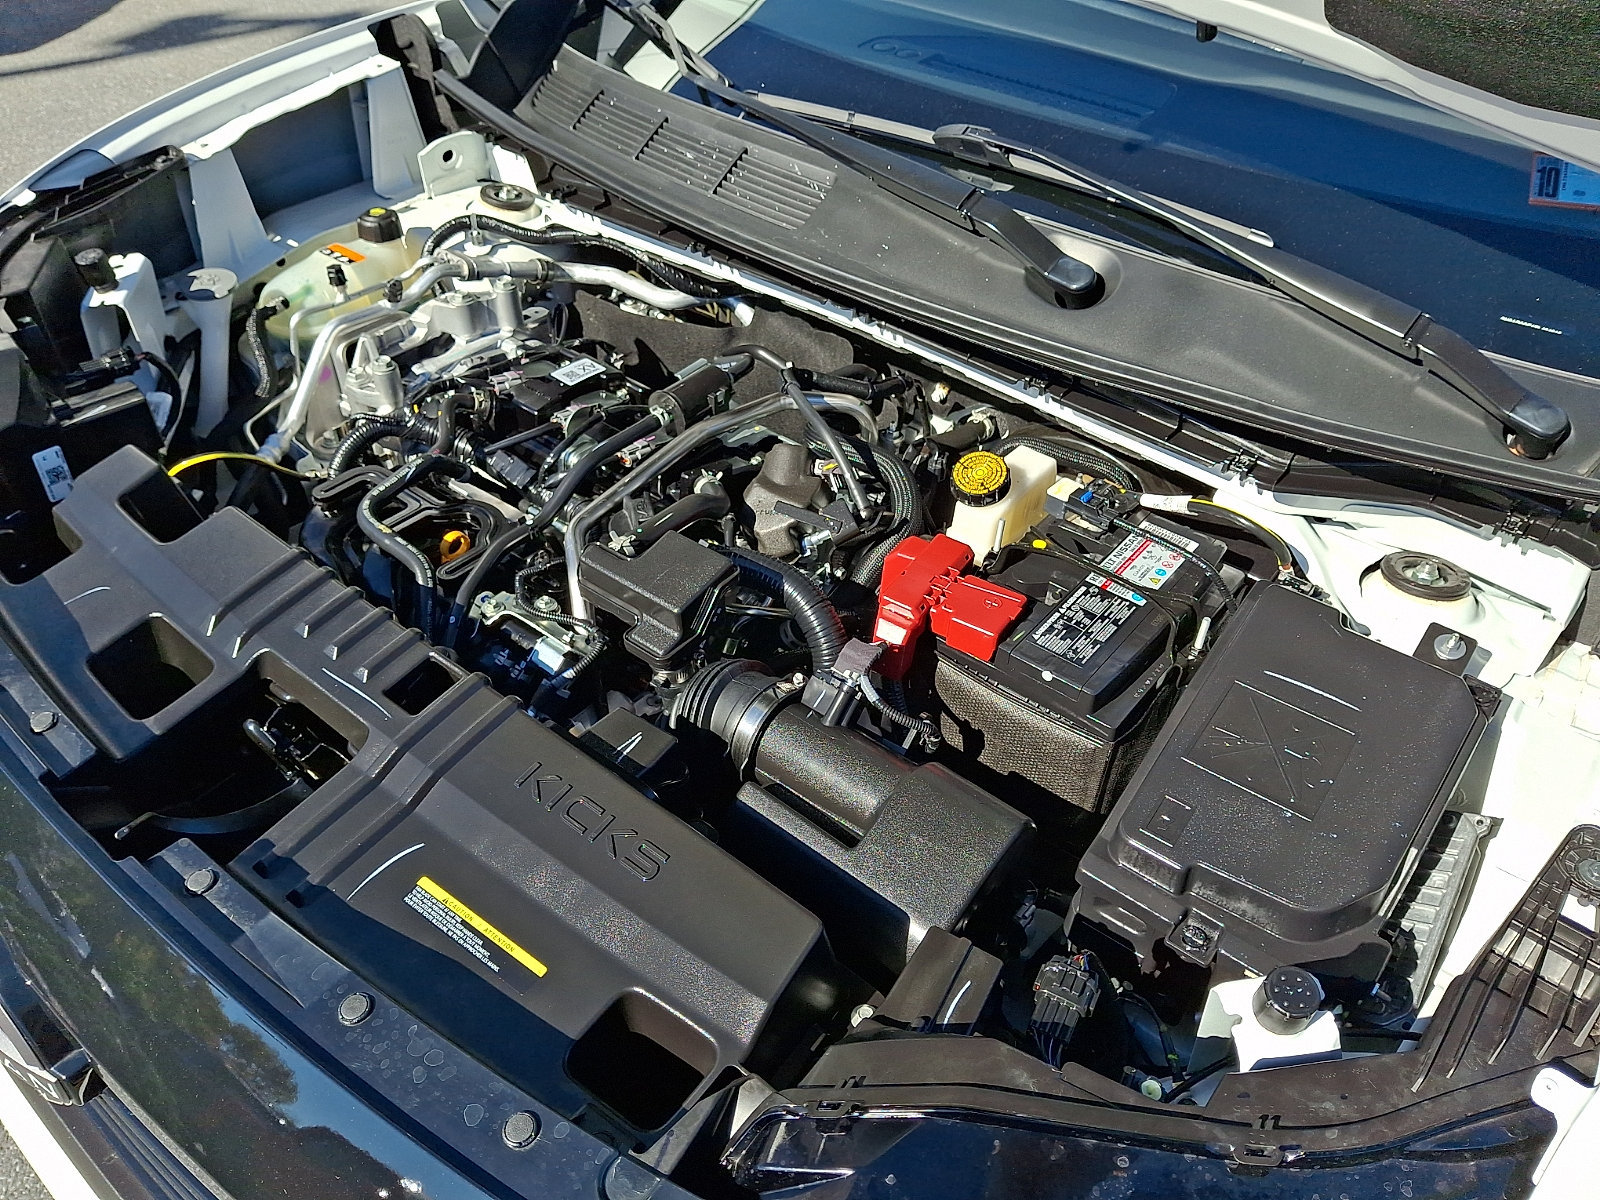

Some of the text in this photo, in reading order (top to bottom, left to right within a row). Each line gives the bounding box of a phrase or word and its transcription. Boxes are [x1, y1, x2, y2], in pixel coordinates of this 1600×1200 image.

[1537, 166, 1561, 198] 10
[513, 761, 671, 882] KICKS
[447, 900, 474, 922] CAUTION
[482, 927, 516, 953] ATTENTION
